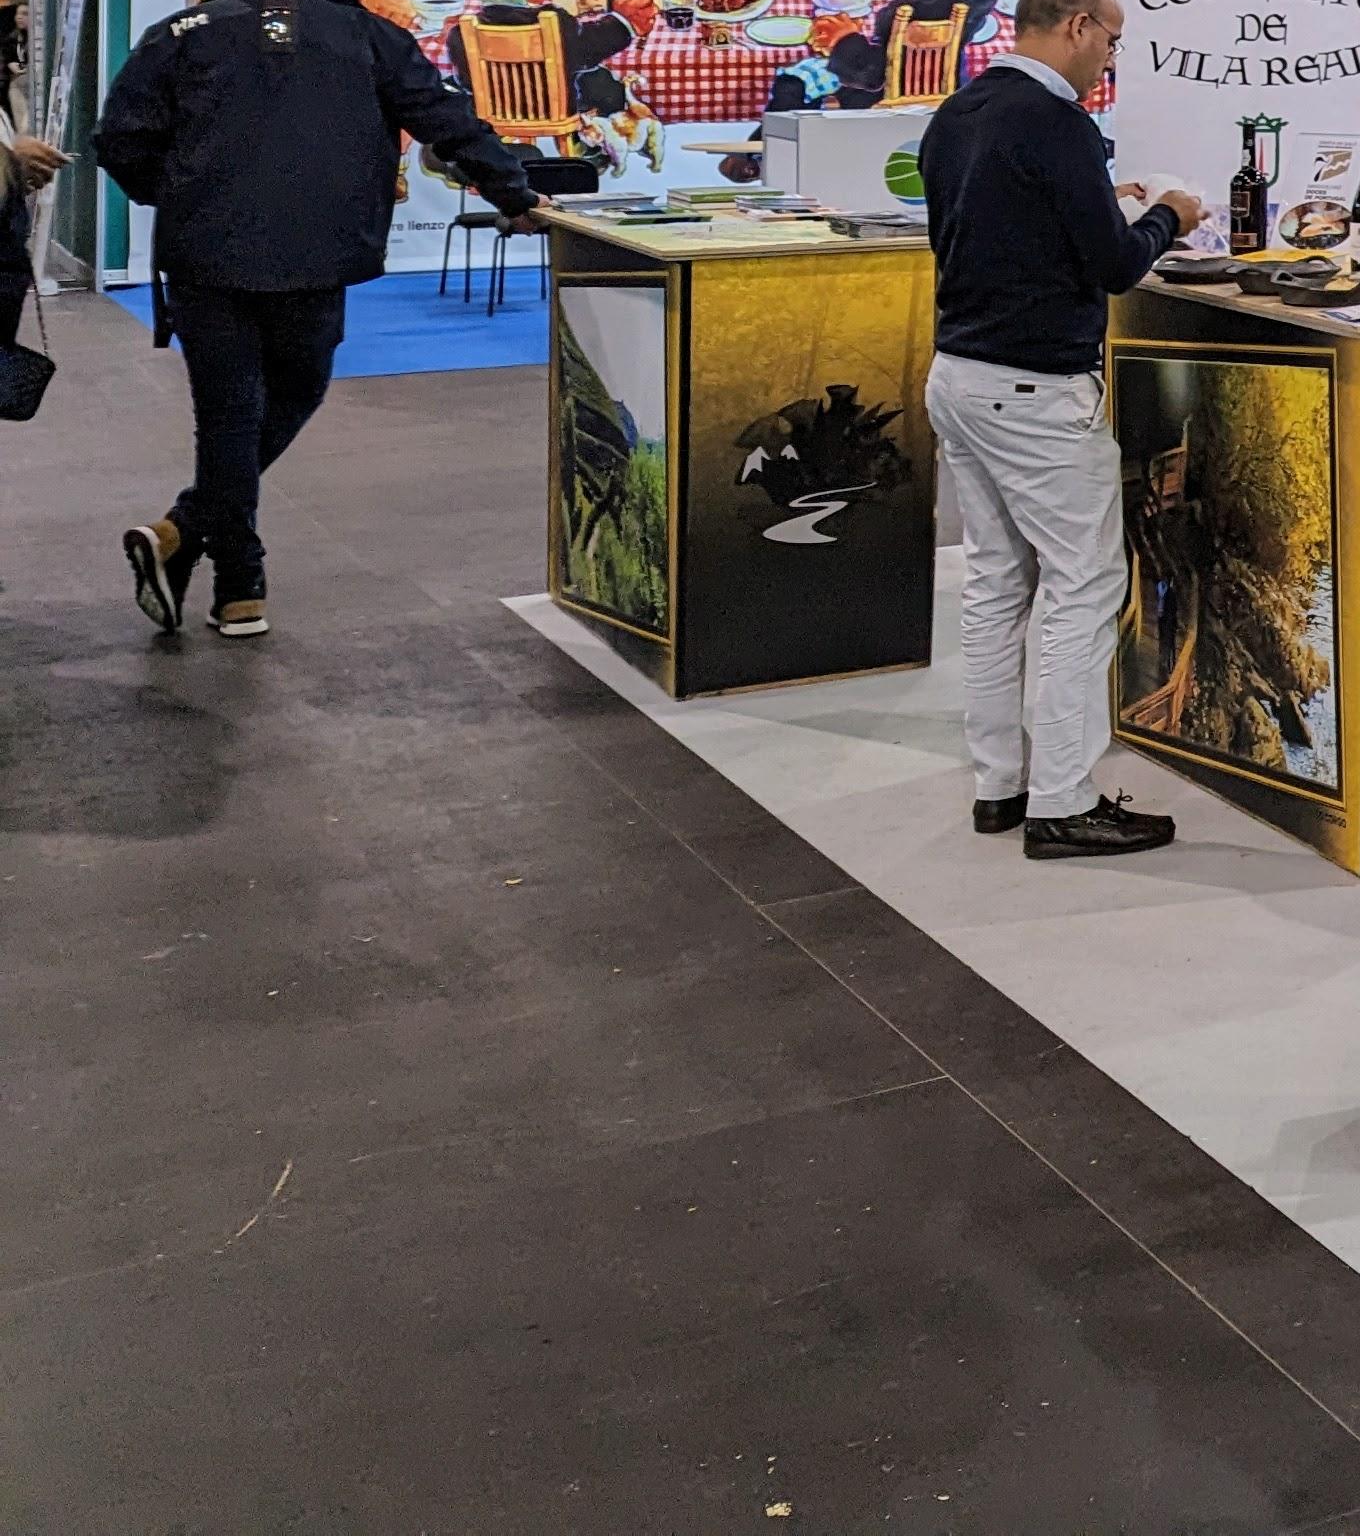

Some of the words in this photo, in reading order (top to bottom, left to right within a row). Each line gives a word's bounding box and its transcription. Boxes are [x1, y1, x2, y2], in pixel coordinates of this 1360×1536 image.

[1235, 14, 1287, 45] DE
[1150, 41, 1251, 89] VILA
[408, 221, 445, 230] lienzo
